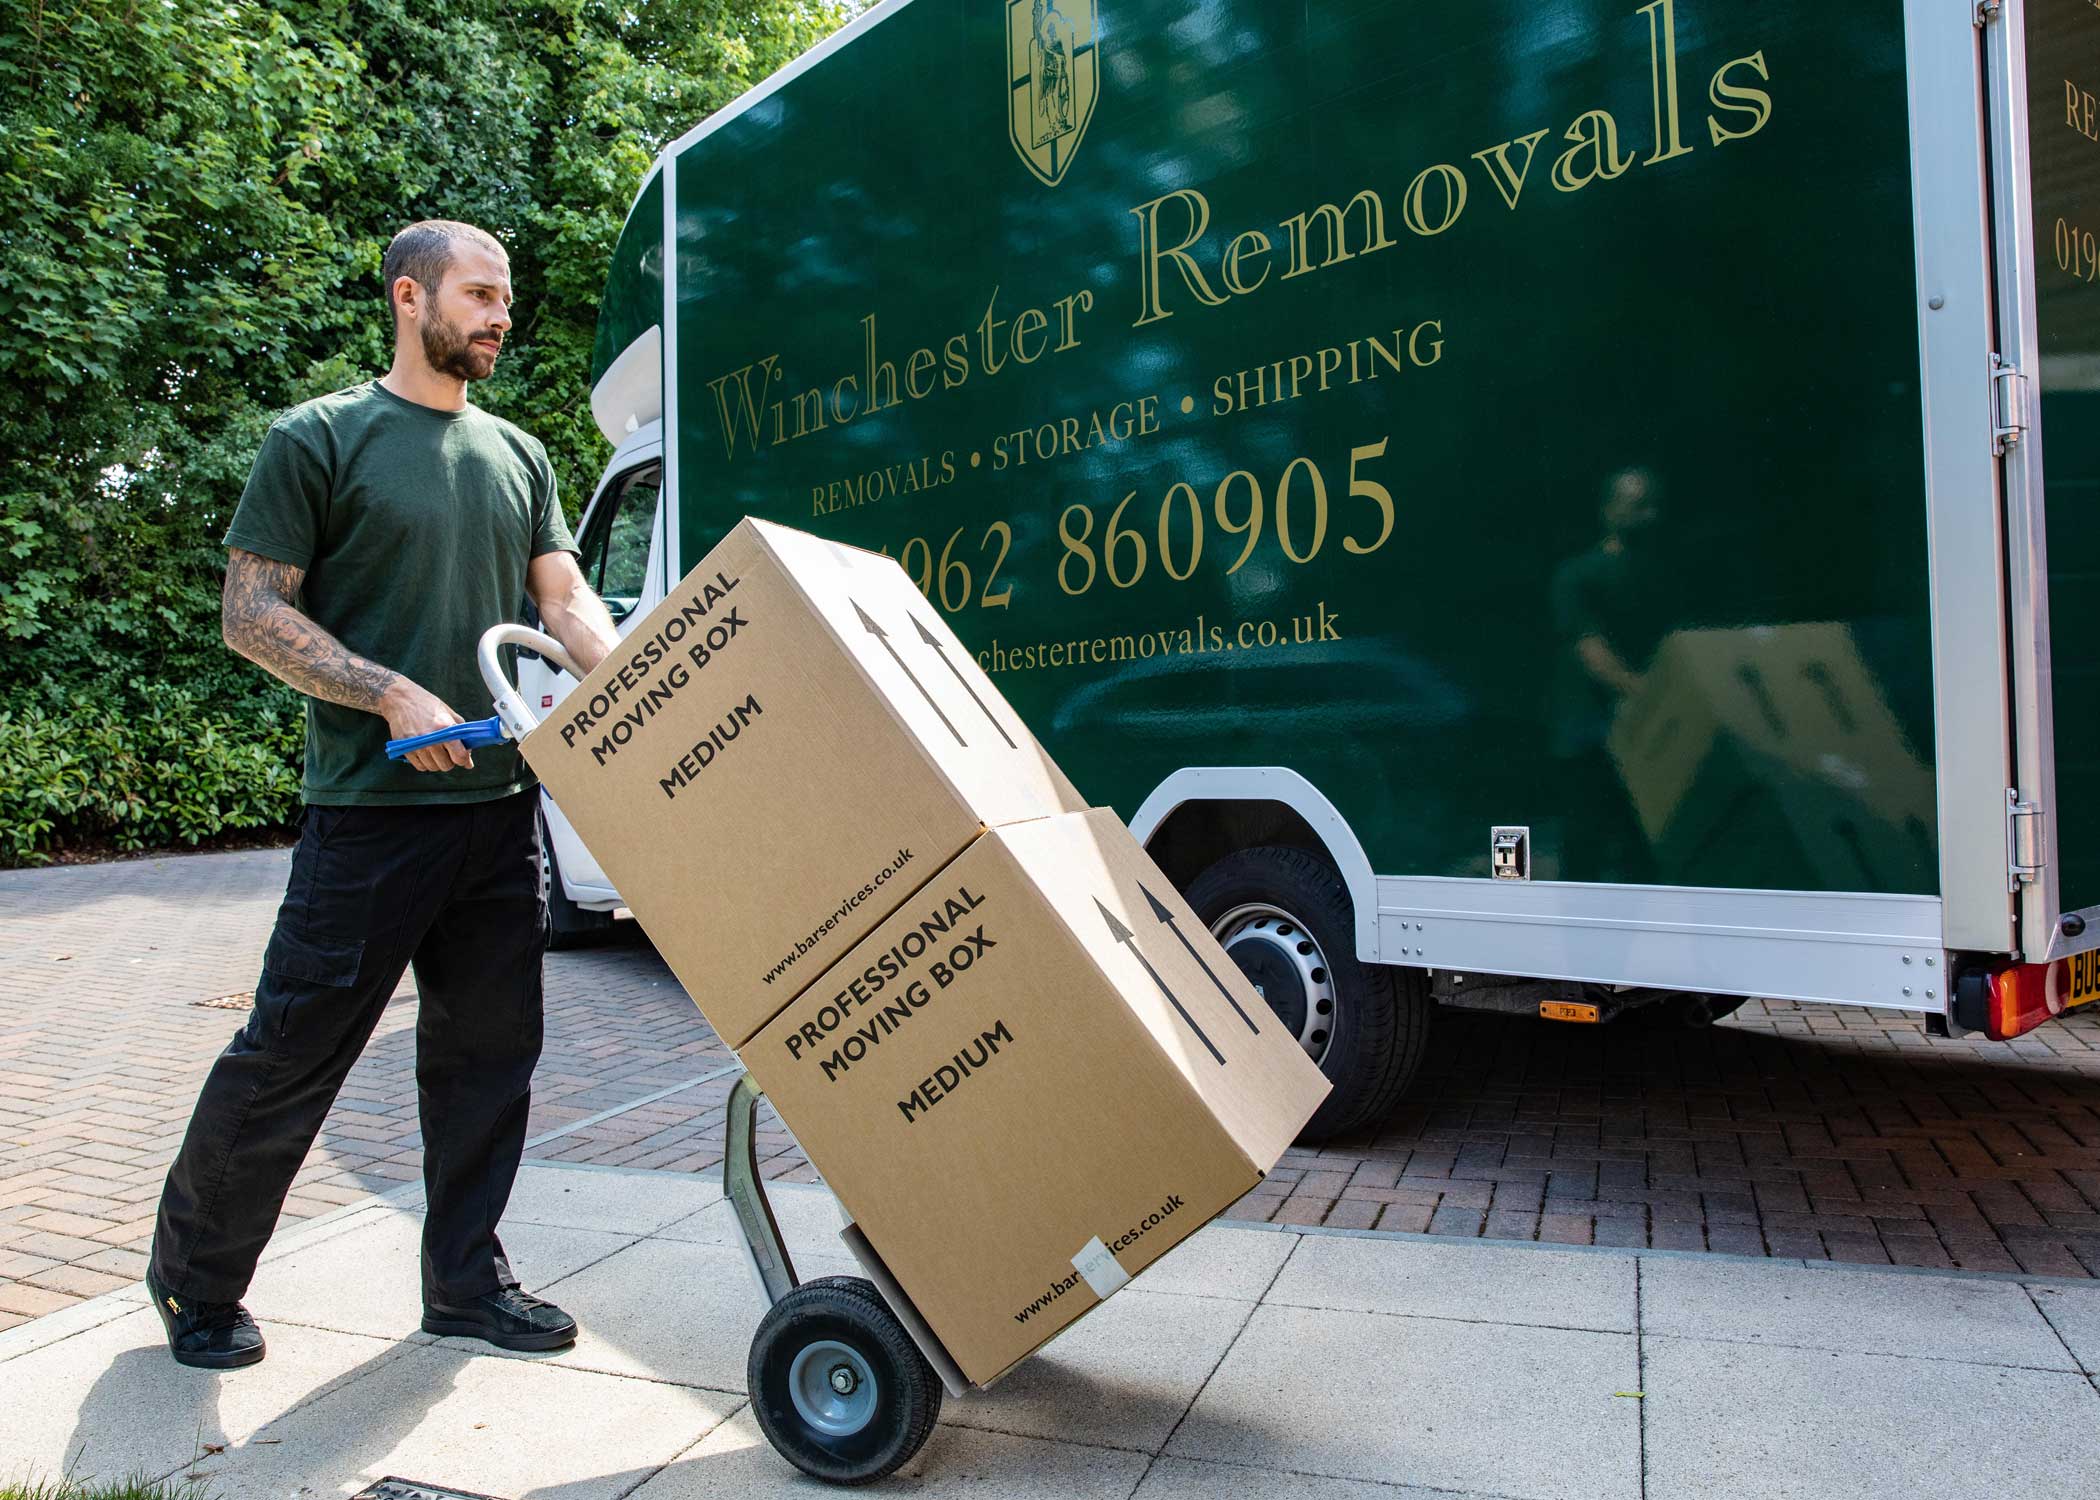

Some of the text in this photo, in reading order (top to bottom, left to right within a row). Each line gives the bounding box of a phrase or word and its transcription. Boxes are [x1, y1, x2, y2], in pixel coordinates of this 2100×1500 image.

[2064, 79, 2100, 142] RE
[706, 0, 1773, 461] Winchester Removals
[2055, 217, 2100, 282] 019
[811, 319, 1446, 517] REMOVALS STORAGE SHIPPING
[879, 436, 1396, 613] 962 860905
[560, 572, 741, 749] PROFESSIONAL
[590, 606, 749, 767] MOVING BOX
[659, 694, 763, 799] MEDIUM
[762, 847, 914, 985] www.barservices.co.uk
[784, 886, 986, 1060] PROFESSIONAL
[819, 924, 997, 1082] MOVING BOX
[896, 1019, 1014, 1123] MEDIUM
